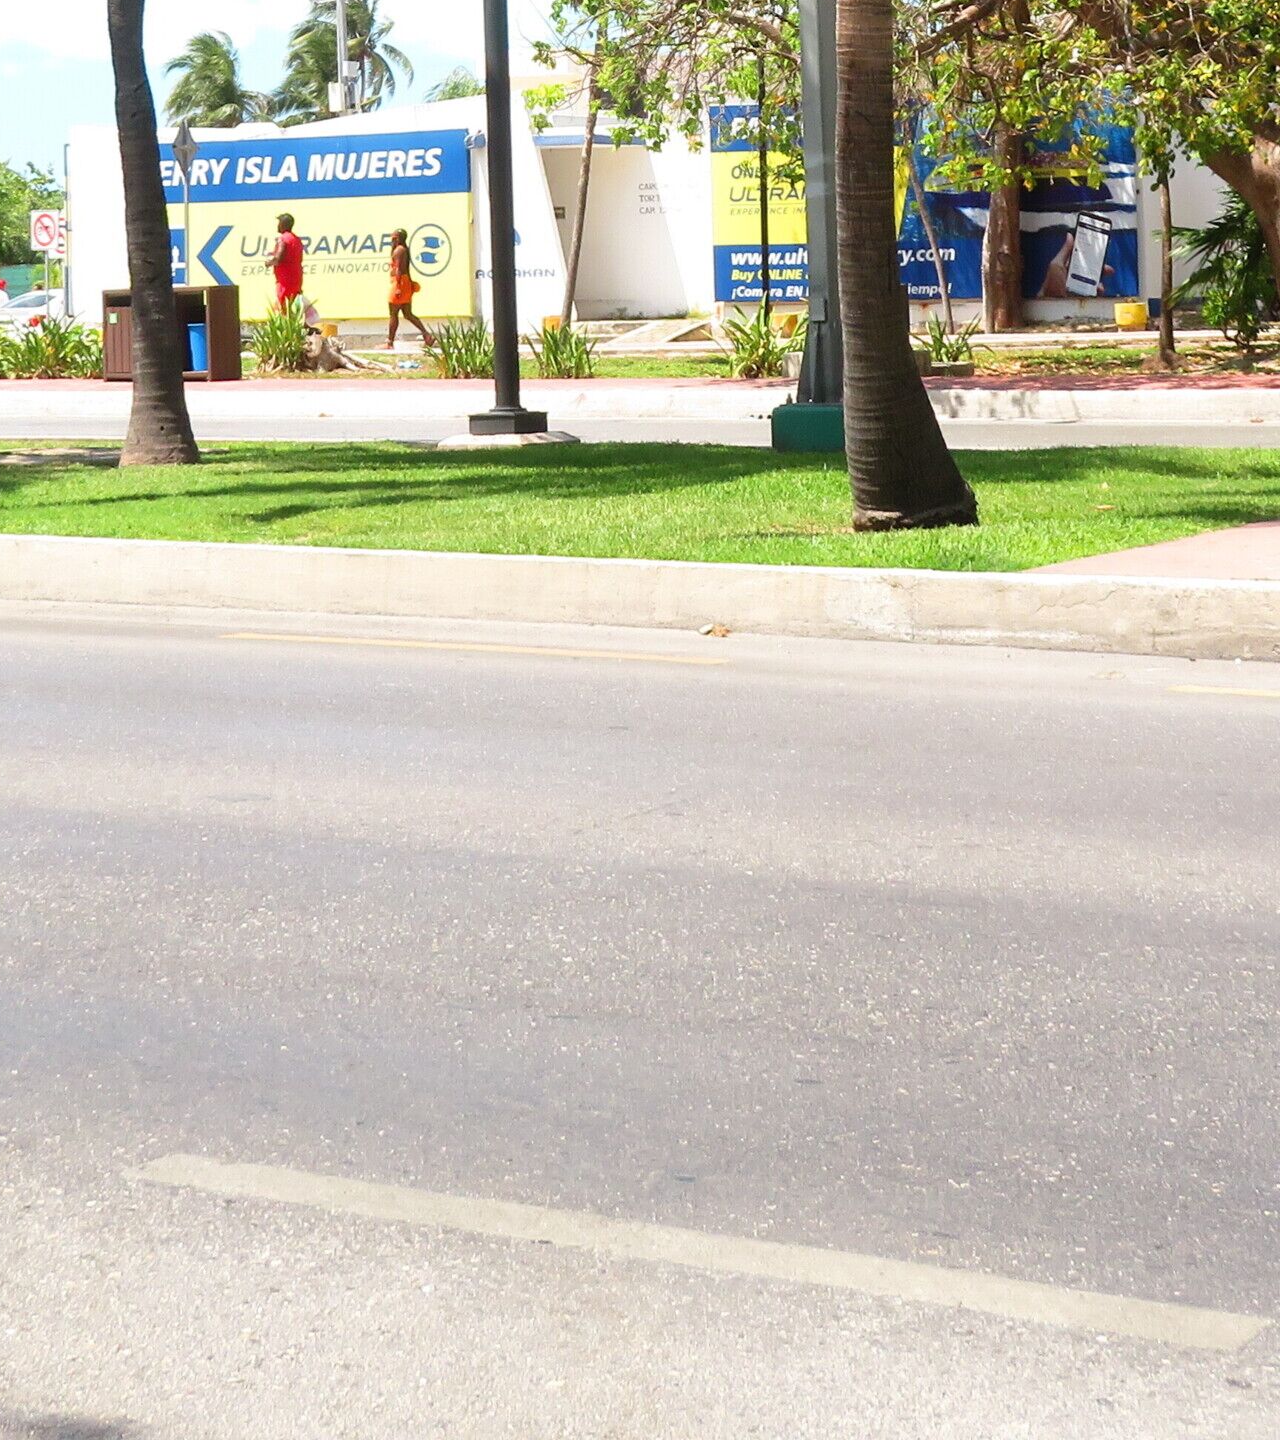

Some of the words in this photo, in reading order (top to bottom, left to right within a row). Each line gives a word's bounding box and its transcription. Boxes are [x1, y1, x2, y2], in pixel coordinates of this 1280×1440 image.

[235, 155, 299, 184] ISLA
[307, 148, 442, 182] MUJERES
[731, 269, 755, 284] Buy
[785, 285, 804, 297] EN
